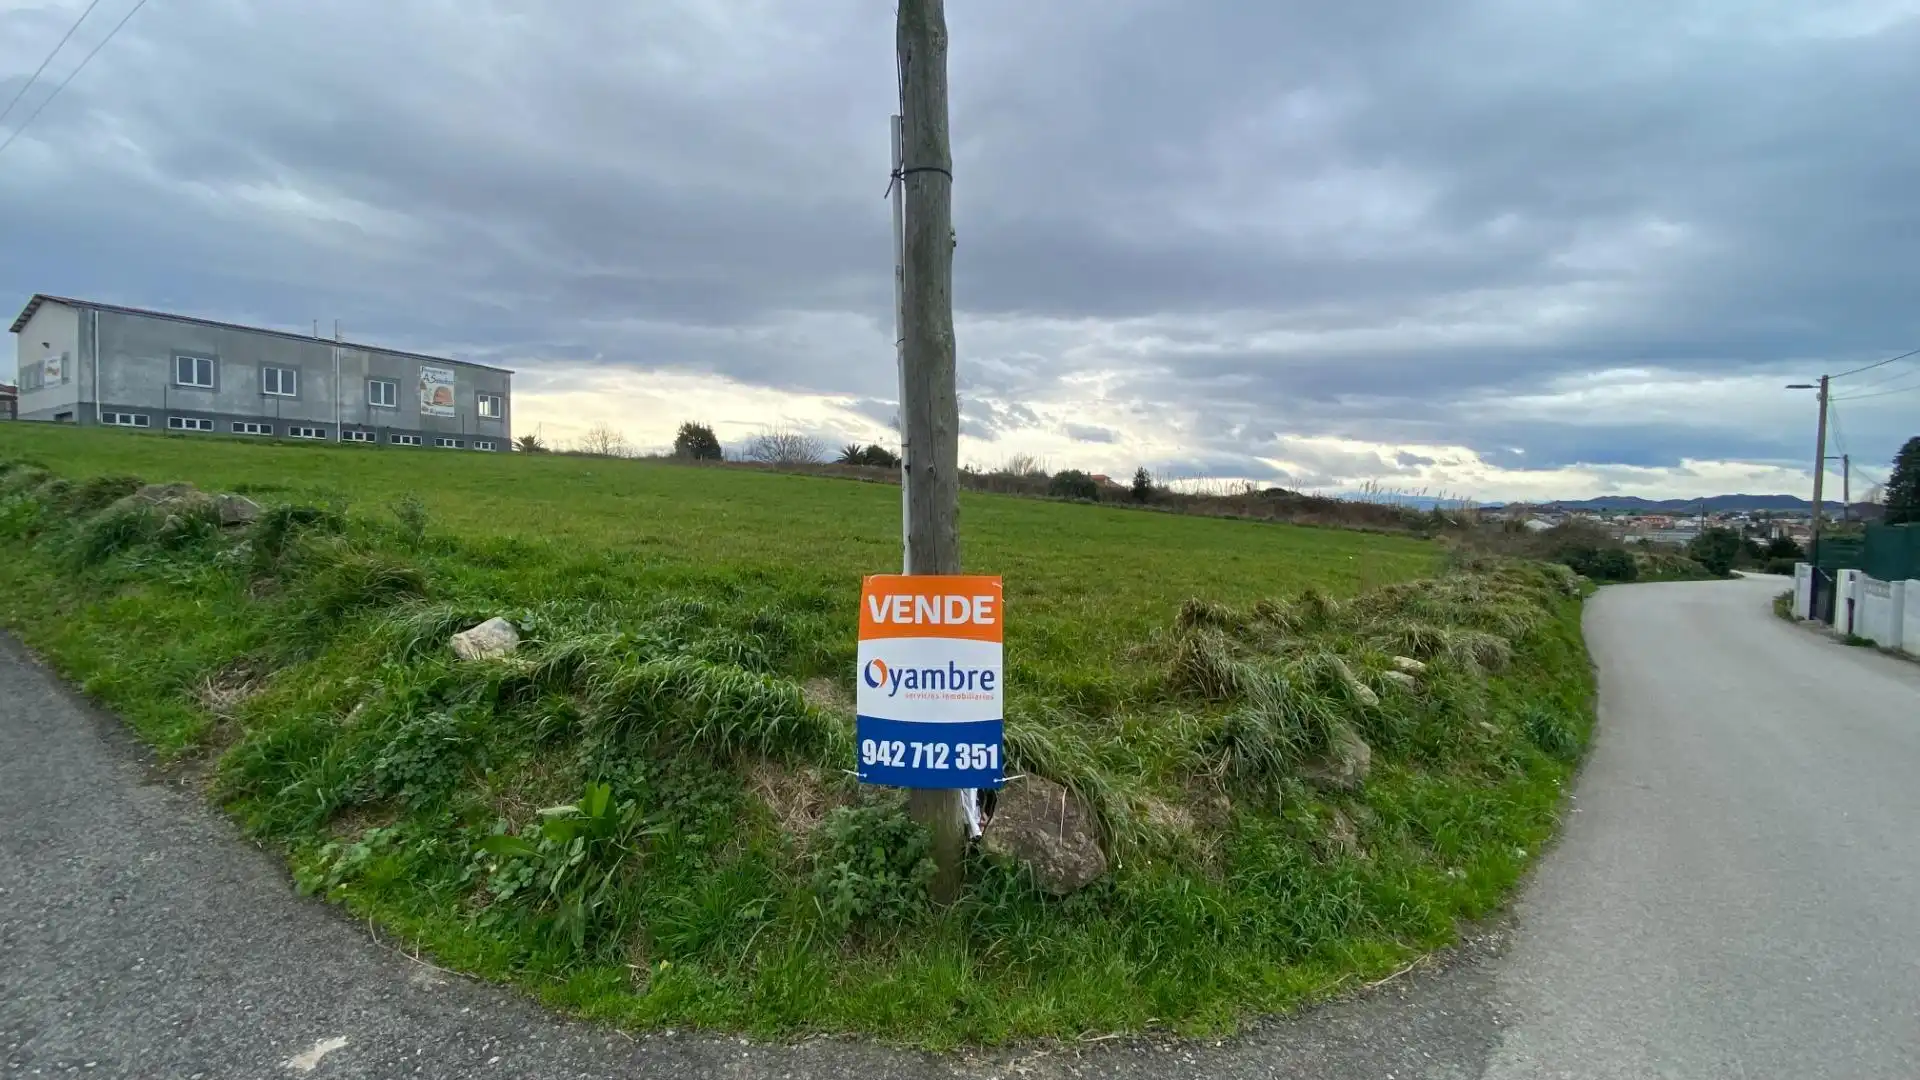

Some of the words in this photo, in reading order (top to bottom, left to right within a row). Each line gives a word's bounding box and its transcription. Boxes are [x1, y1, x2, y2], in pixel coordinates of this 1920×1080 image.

[868, 594, 996, 625] VENDE
[864, 658, 995, 697] Oyambre
[943, 692, 995, 701] inmobiliarios
[862, 739, 905, 767] 942
[911, 742, 949, 770] 712
[955, 743, 998, 770] 351
